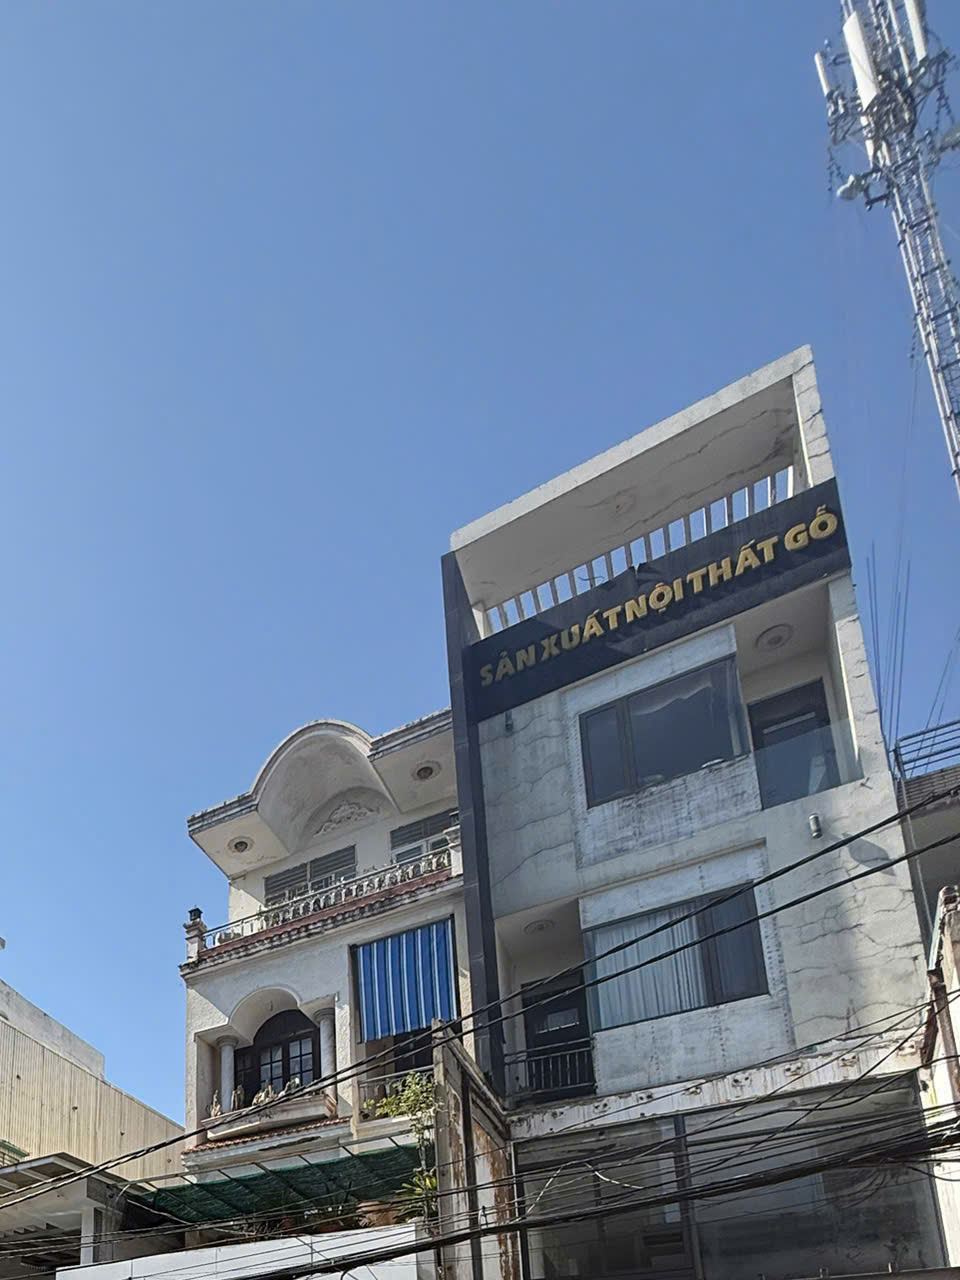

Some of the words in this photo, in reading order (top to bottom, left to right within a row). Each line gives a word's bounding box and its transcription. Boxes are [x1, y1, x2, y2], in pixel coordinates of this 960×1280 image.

[479, 644, 537, 688] SẢN
[540, 604, 622, 659] XUẤT
[625, 575, 685, 623] NỘI
[686, 534, 780, 595] THẤT
[783, 504, 839, 552] GỖ
